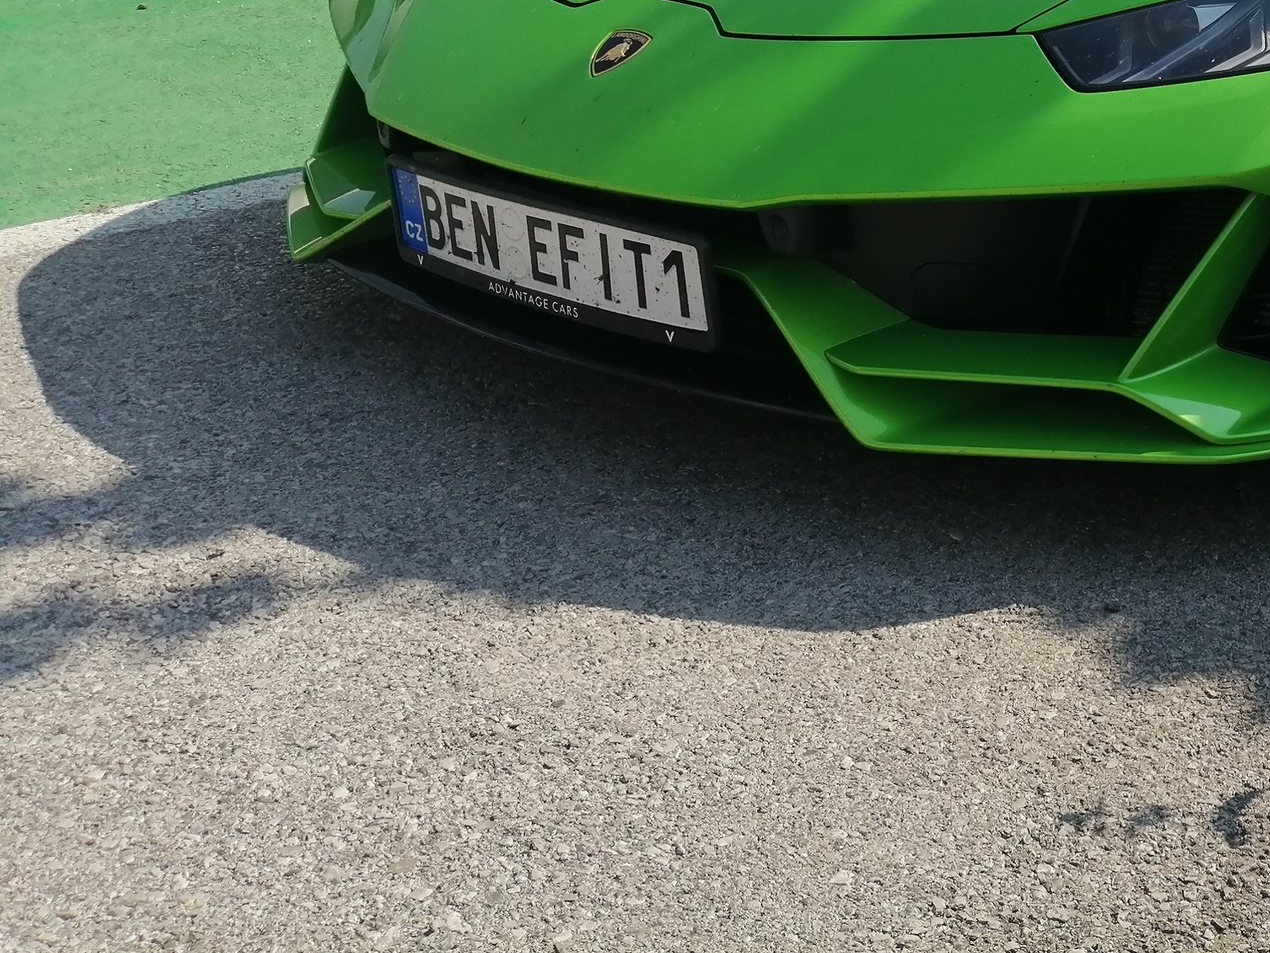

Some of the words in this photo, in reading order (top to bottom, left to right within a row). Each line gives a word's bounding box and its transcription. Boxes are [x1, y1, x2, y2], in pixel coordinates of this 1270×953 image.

[405, 219, 424, 243] CZ
[419, 183, 501, 271] BEN
[526, 214, 691, 319] EFIT1
[488, 281, 549, 311] ADVANTAGE
[551, 300, 579, 319] CARS
